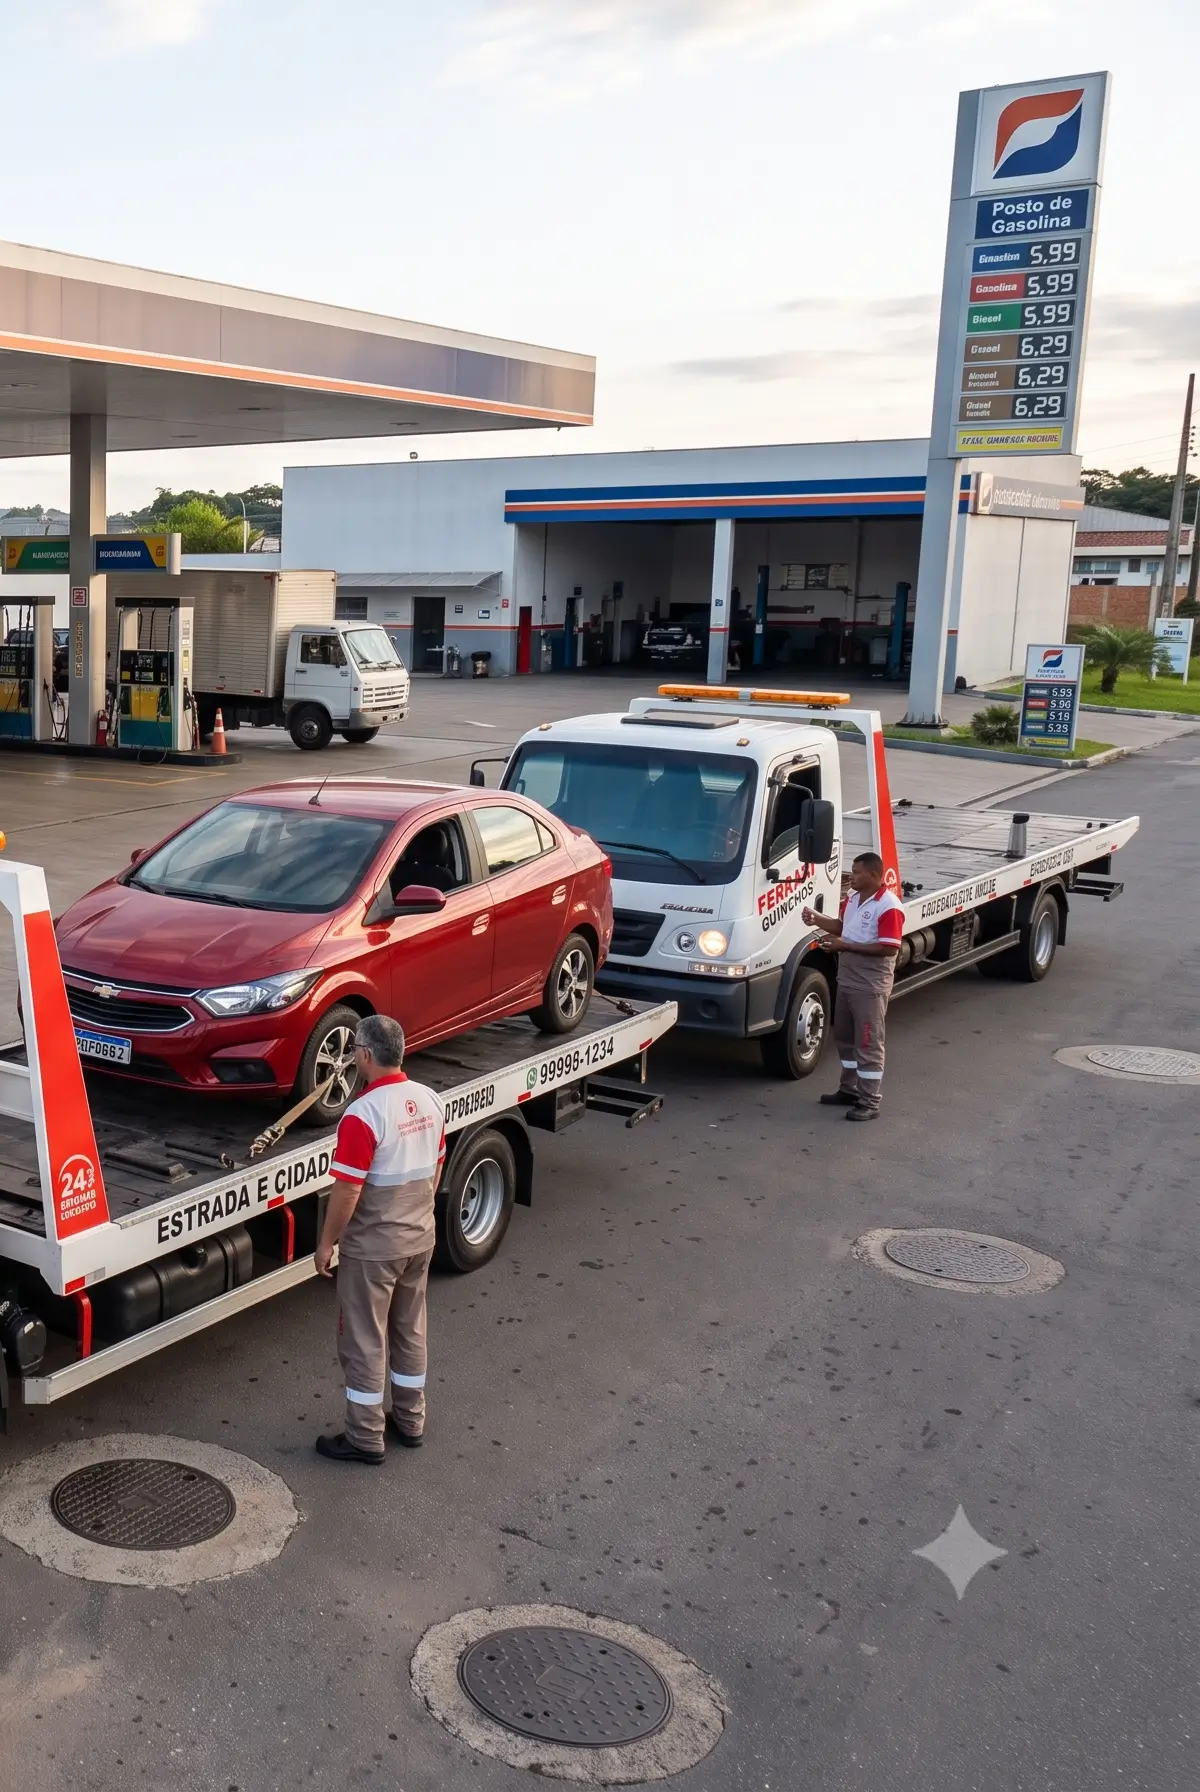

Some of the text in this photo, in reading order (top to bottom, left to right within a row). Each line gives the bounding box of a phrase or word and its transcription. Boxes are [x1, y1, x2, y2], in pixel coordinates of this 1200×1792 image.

[992, 195, 1073, 216] Posto de
[991, 215, 1072, 235] Gasolina
[1030, 242, 1076, 265] 5,99
[1027, 273, 1074, 295] 5,99
[1024, 304, 1071, 325] 5,99
[1021, 335, 1067, 356] 6,29
[1018, 366, 1064, 387] 6,29
[1015, 396, 1061, 417] 6,29
[761, 881, 815, 932] GUINCHOS
[61, 1167, 87, 1198] 24
[158, 1184, 250, 1244] ESTRADA
[257, 1175, 268, 1203] E
[274, 1148, 336, 1195] CIDAD
